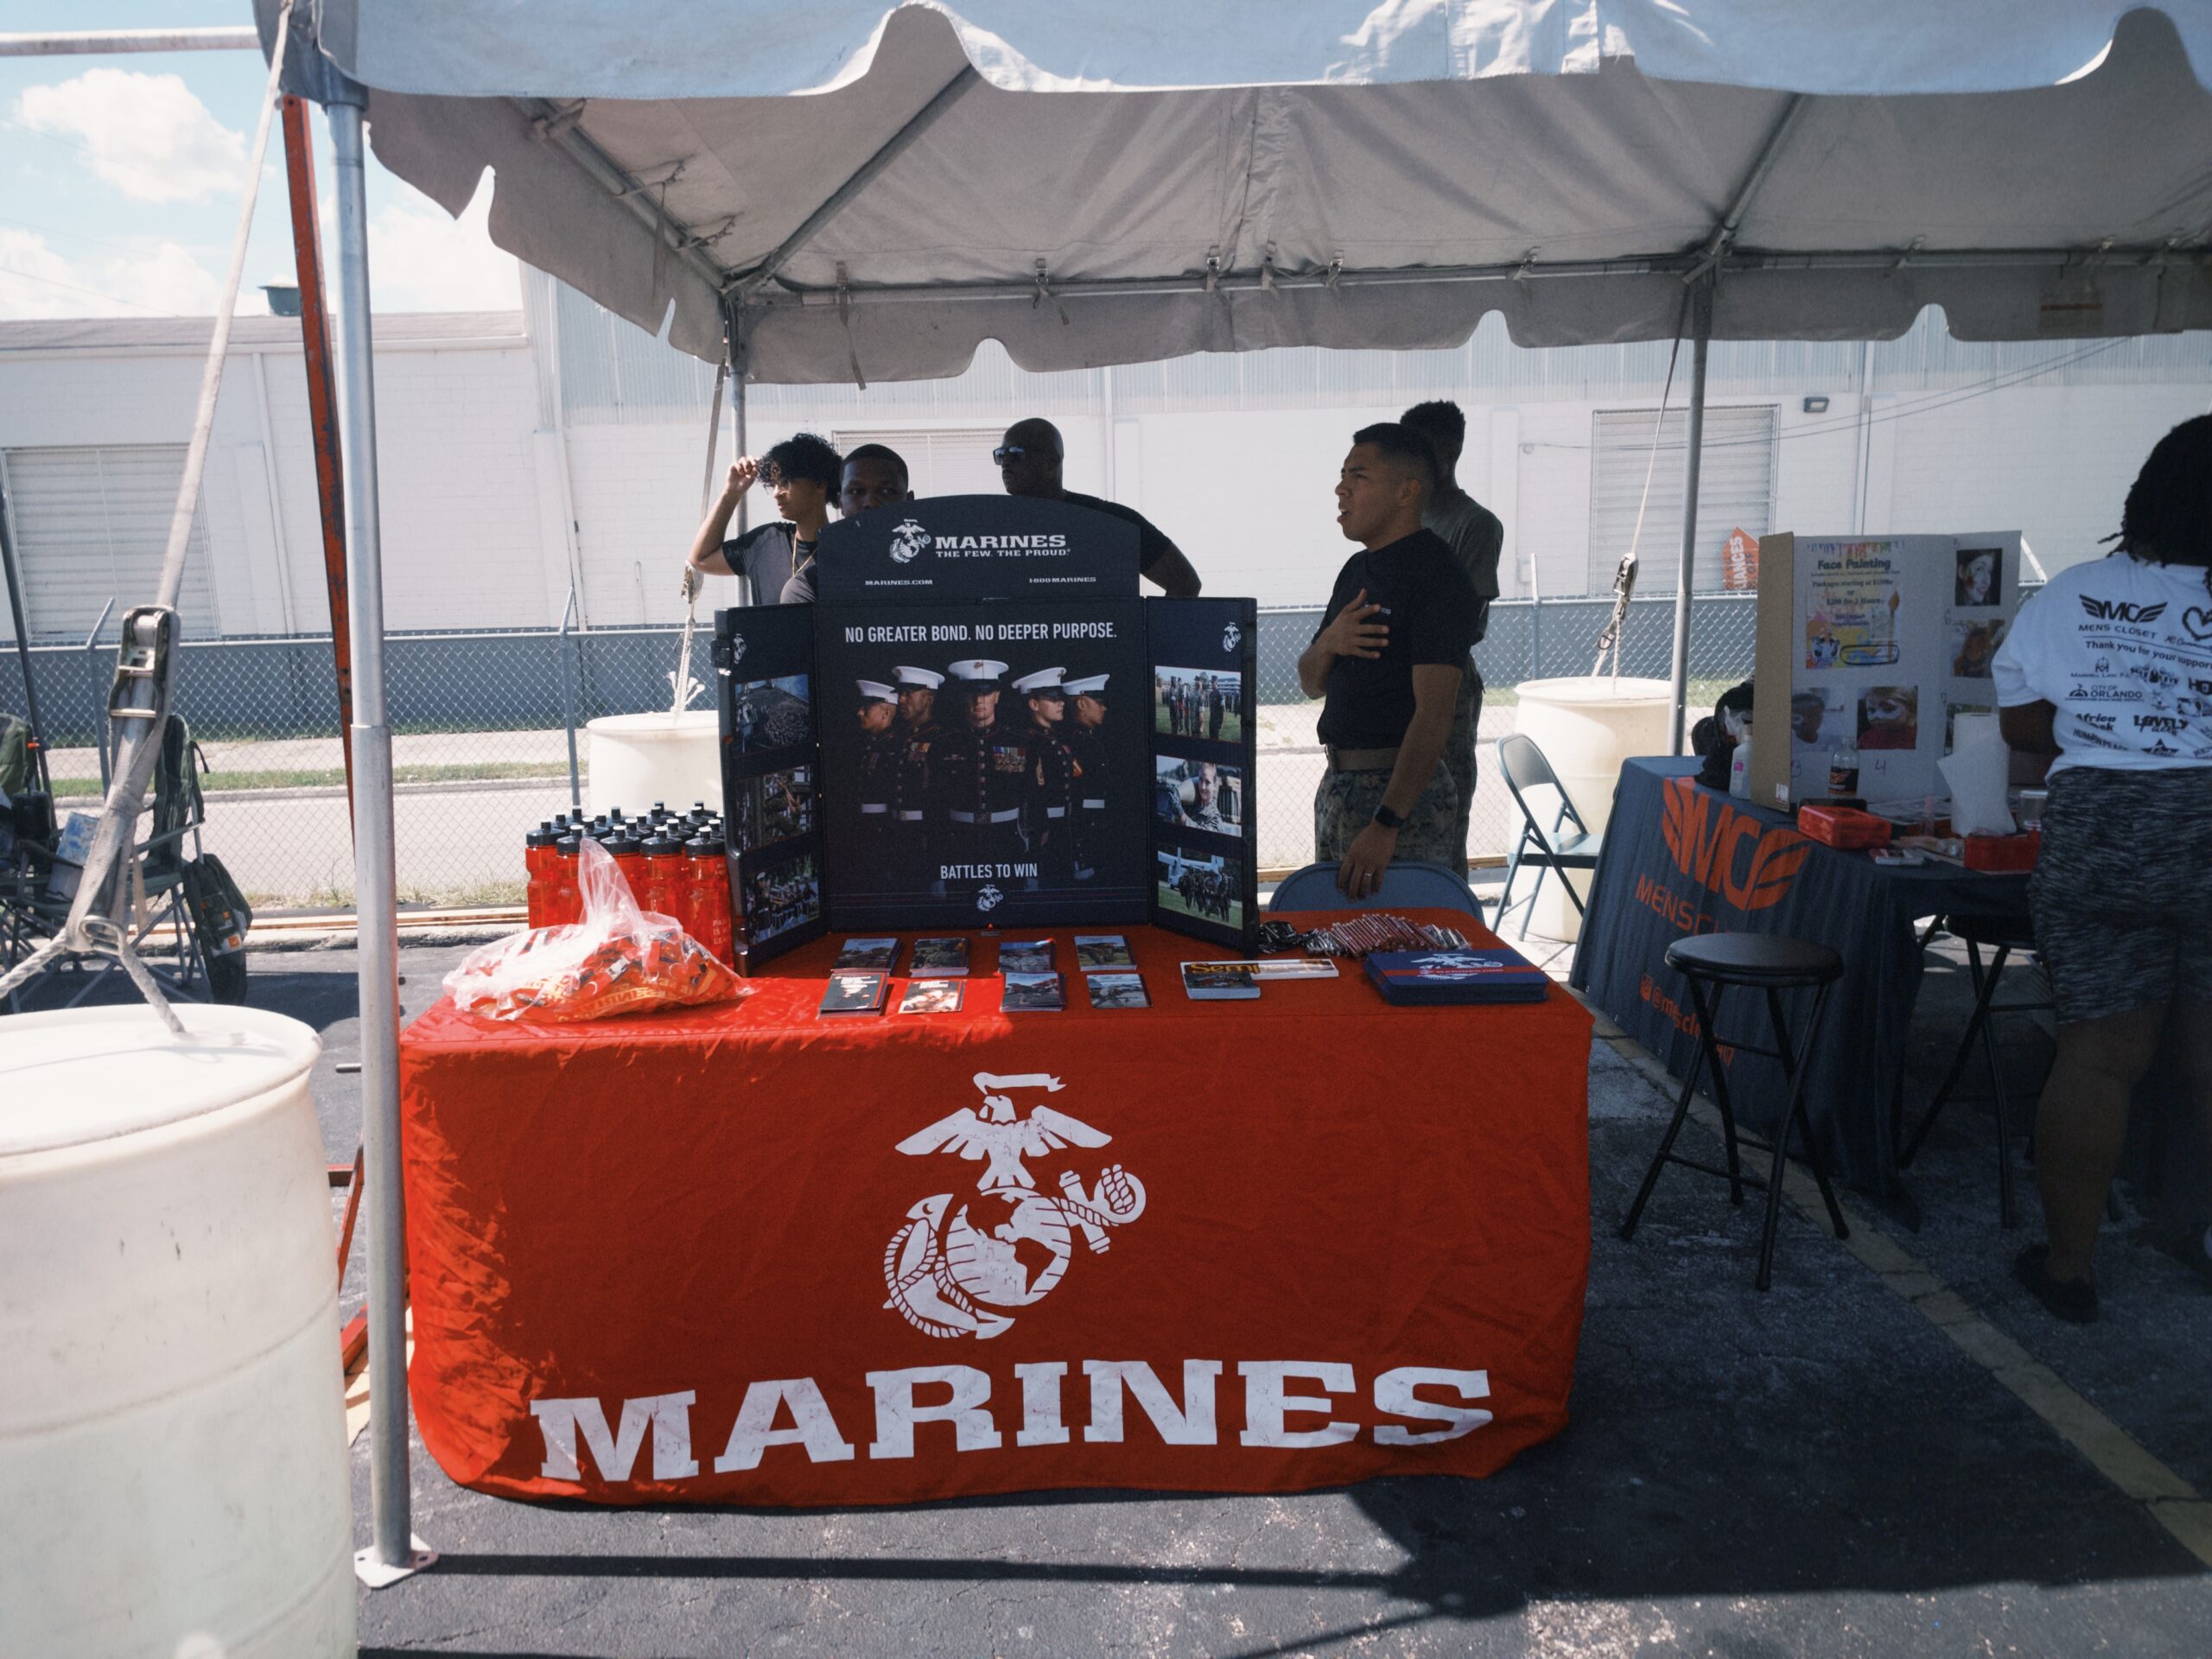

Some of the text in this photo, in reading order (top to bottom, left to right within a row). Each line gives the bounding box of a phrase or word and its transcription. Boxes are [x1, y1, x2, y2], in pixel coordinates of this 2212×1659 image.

[936, 534, 1066, 549] MARINES
[1817, 557, 1891, 571] Face Painting
[845, 621, 1117, 643] NO GREATER BOND. NO DEEPER PURPOSE.
[2078, 623, 2158, 639] MENS CLOSET
[2085, 640, 2114, 650] Thank
[2117, 643, 2137, 654] you
[2139, 645, 2151, 656] for
[2152, 649, 2177, 662] your
[2090, 690, 2143, 699] ORLANDO
[1875, 759, 1887, 776] 4
[940, 863, 1038, 880] BATTLES TO WIN
[1636, 872, 1695, 931] MENS
[529, 1358, 1493, 1484] MARINES
